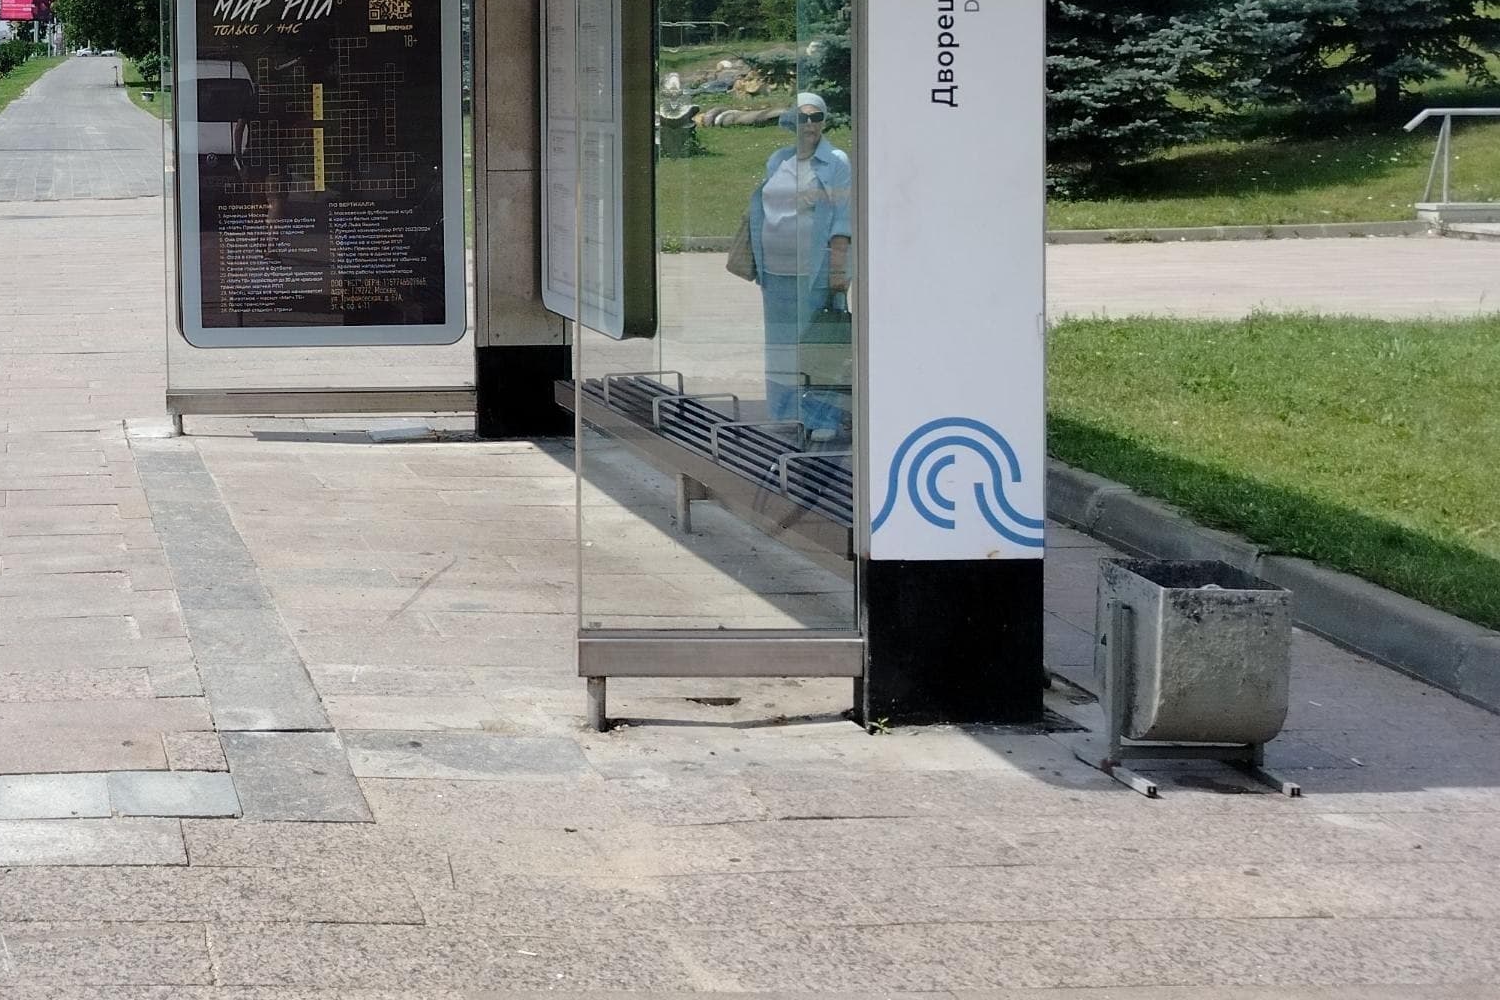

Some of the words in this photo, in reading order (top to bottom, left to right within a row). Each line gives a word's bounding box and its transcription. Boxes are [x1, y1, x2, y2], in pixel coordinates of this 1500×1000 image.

[213, 24, 259, 36] ТОЛЬКО
[263, 24, 273, 34] У
[276, 23, 302, 34] НАС
[404, 34, 418, 47] 18+
